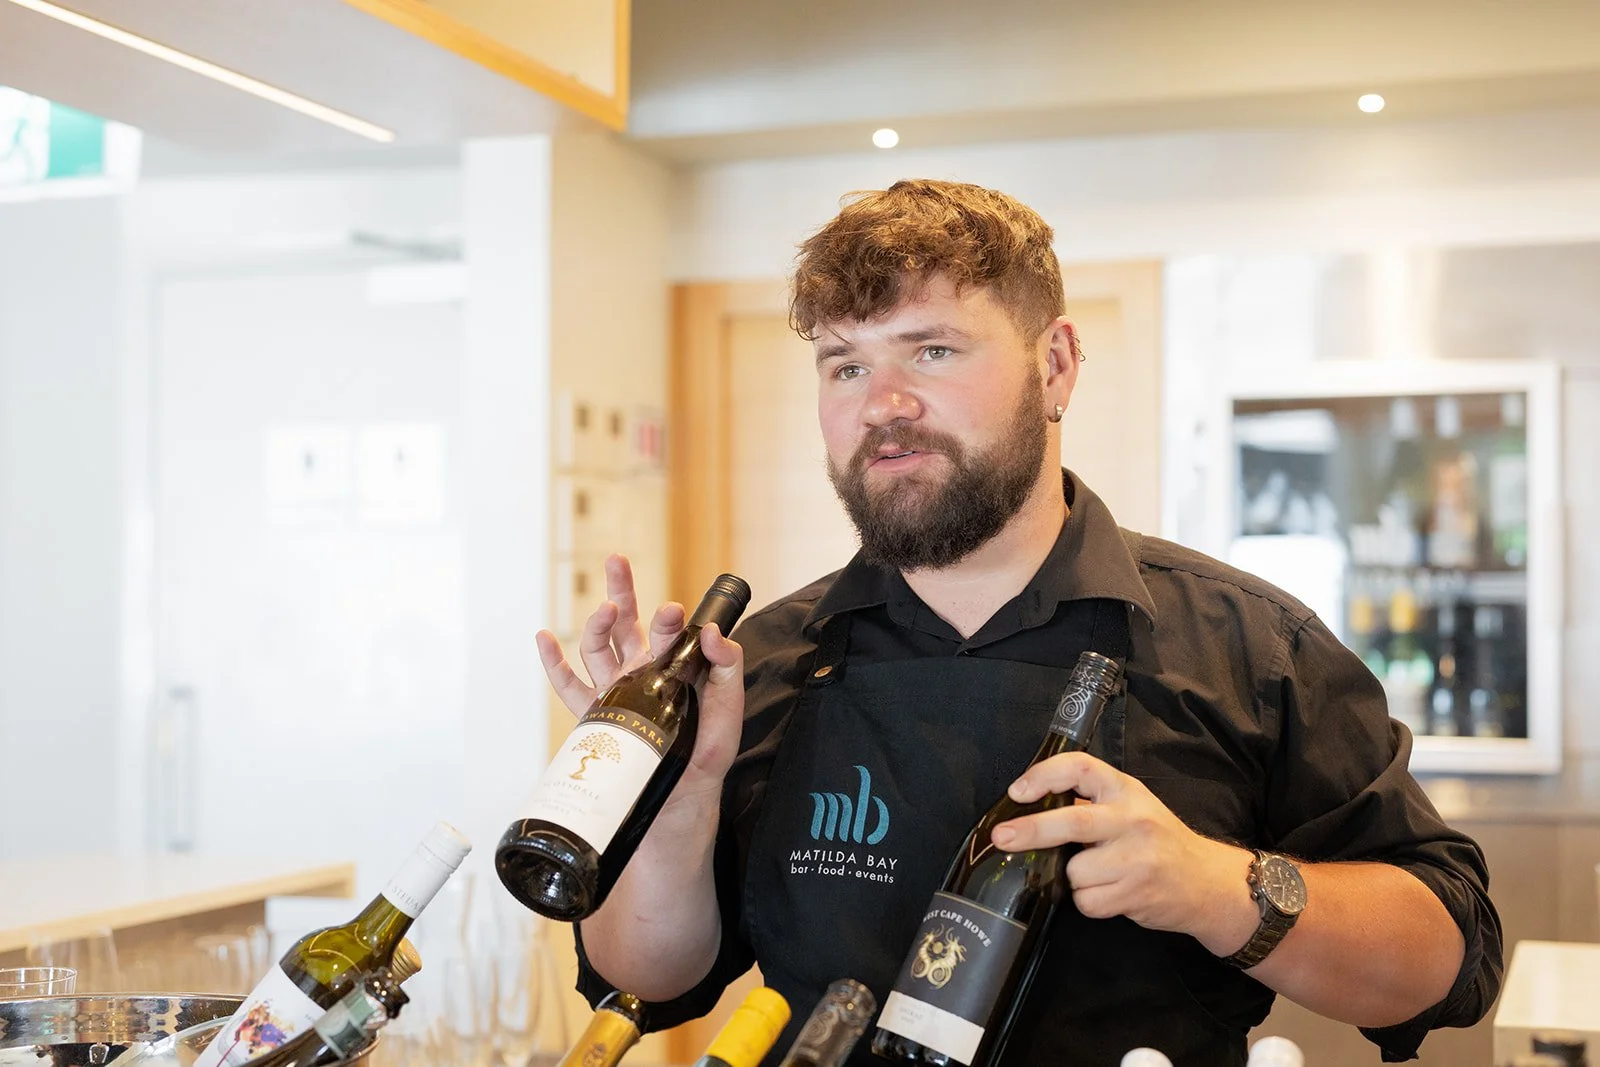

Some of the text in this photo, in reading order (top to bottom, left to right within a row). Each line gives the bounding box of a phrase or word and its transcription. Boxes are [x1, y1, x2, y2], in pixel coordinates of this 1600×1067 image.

[632, 720, 665, 748] PARK
[789, 850, 898, 870] MATILDA BAY
[790, 863, 894, 884] bar food events
[940, 909, 962, 924] CAPE
[963, 918, 993, 948] HOWE
